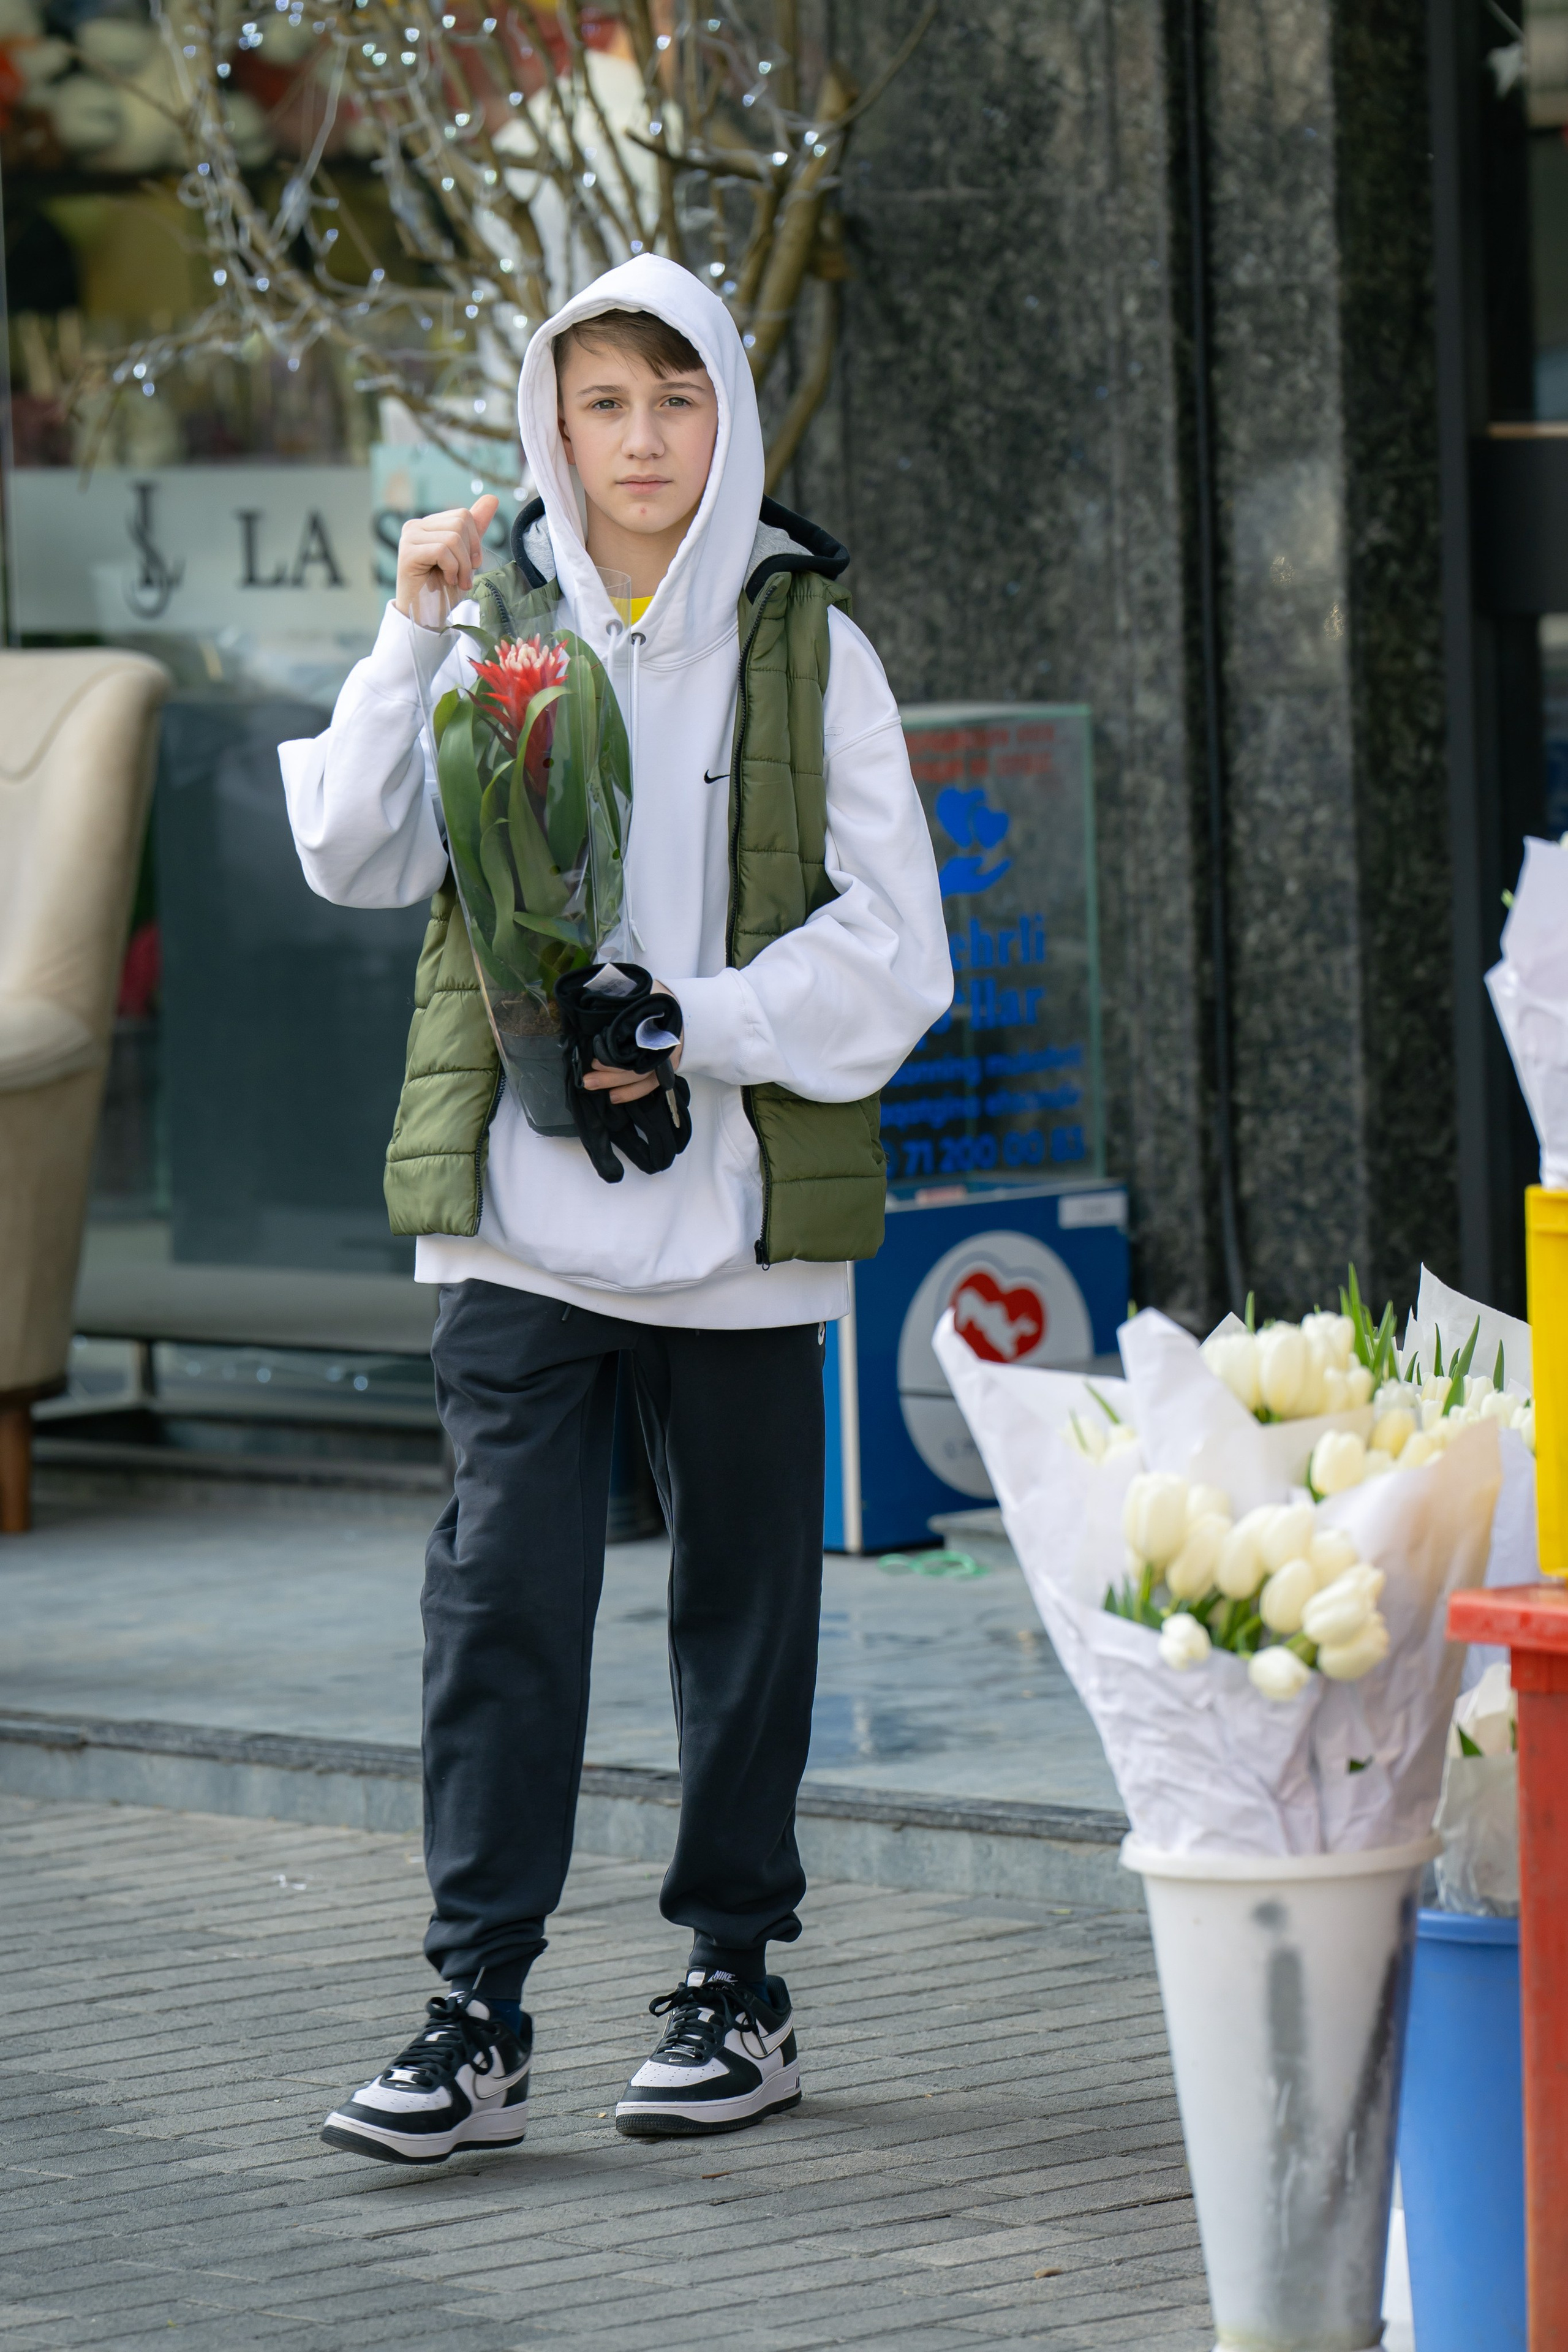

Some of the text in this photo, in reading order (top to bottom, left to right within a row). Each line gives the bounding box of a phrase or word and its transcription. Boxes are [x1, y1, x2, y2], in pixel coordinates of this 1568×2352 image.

[236, 510, 345, 589] LA
[949, 914, 1045, 971] ehrli
[714, 1970, 733, 1981] NIKE
